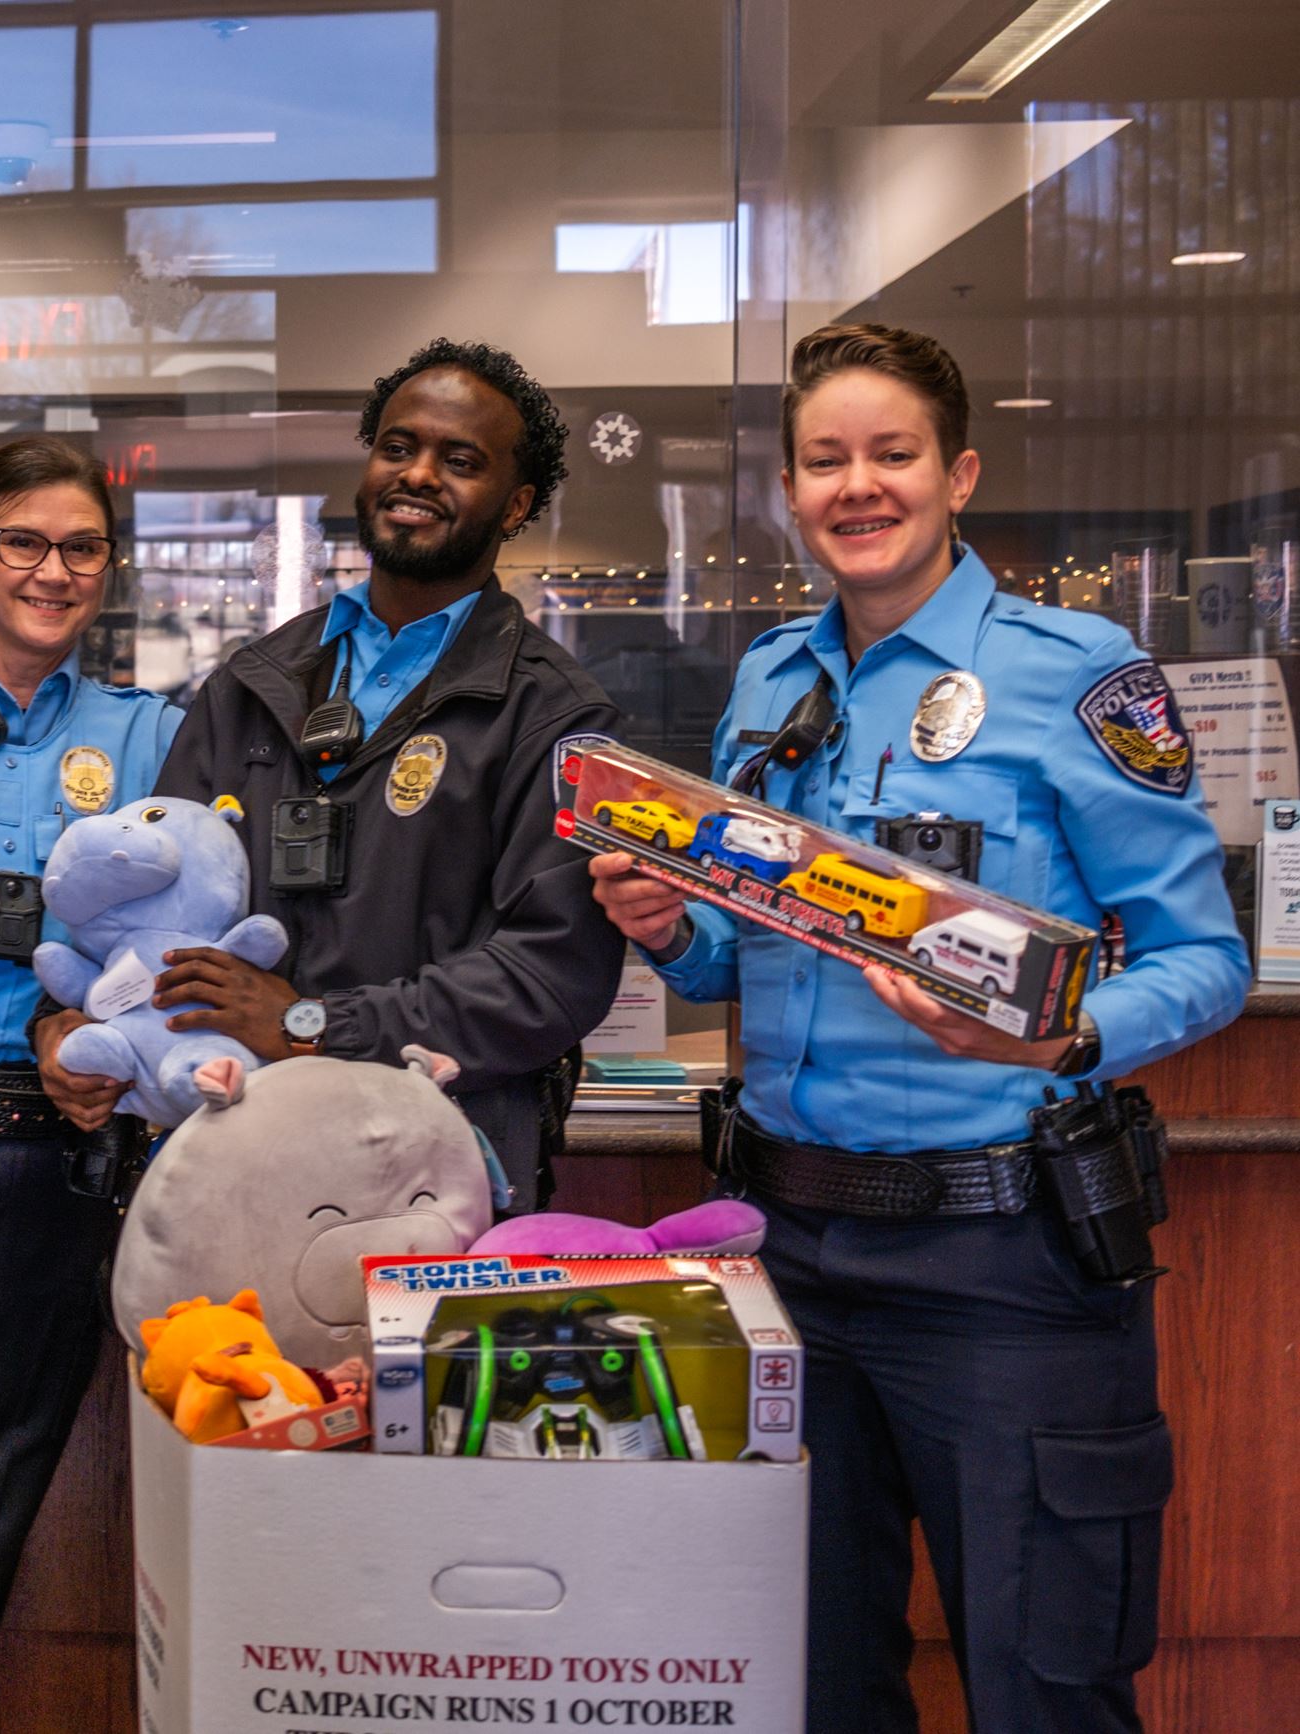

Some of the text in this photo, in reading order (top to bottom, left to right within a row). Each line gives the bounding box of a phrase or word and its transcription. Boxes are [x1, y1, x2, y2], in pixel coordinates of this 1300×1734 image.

[1091, 676, 1167, 731] POLICE
[1194, 719, 1217, 732] $10
[708, 864, 737, 890] MY
[738, 878, 776, 905] CITY
[778, 894, 847, 937] STREETS
[378, 1260, 503, 1281] STORM
[402, 1269, 564, 1292] TWISTER
[384, 1422, 410, 1439] 6+
[241, 1644, 752, 1684] NEW, UNWRAPPED TOYS ONLY
[252, 1687, 736, 1726] CAMPAIGN RUNS 1 OCTOBER
